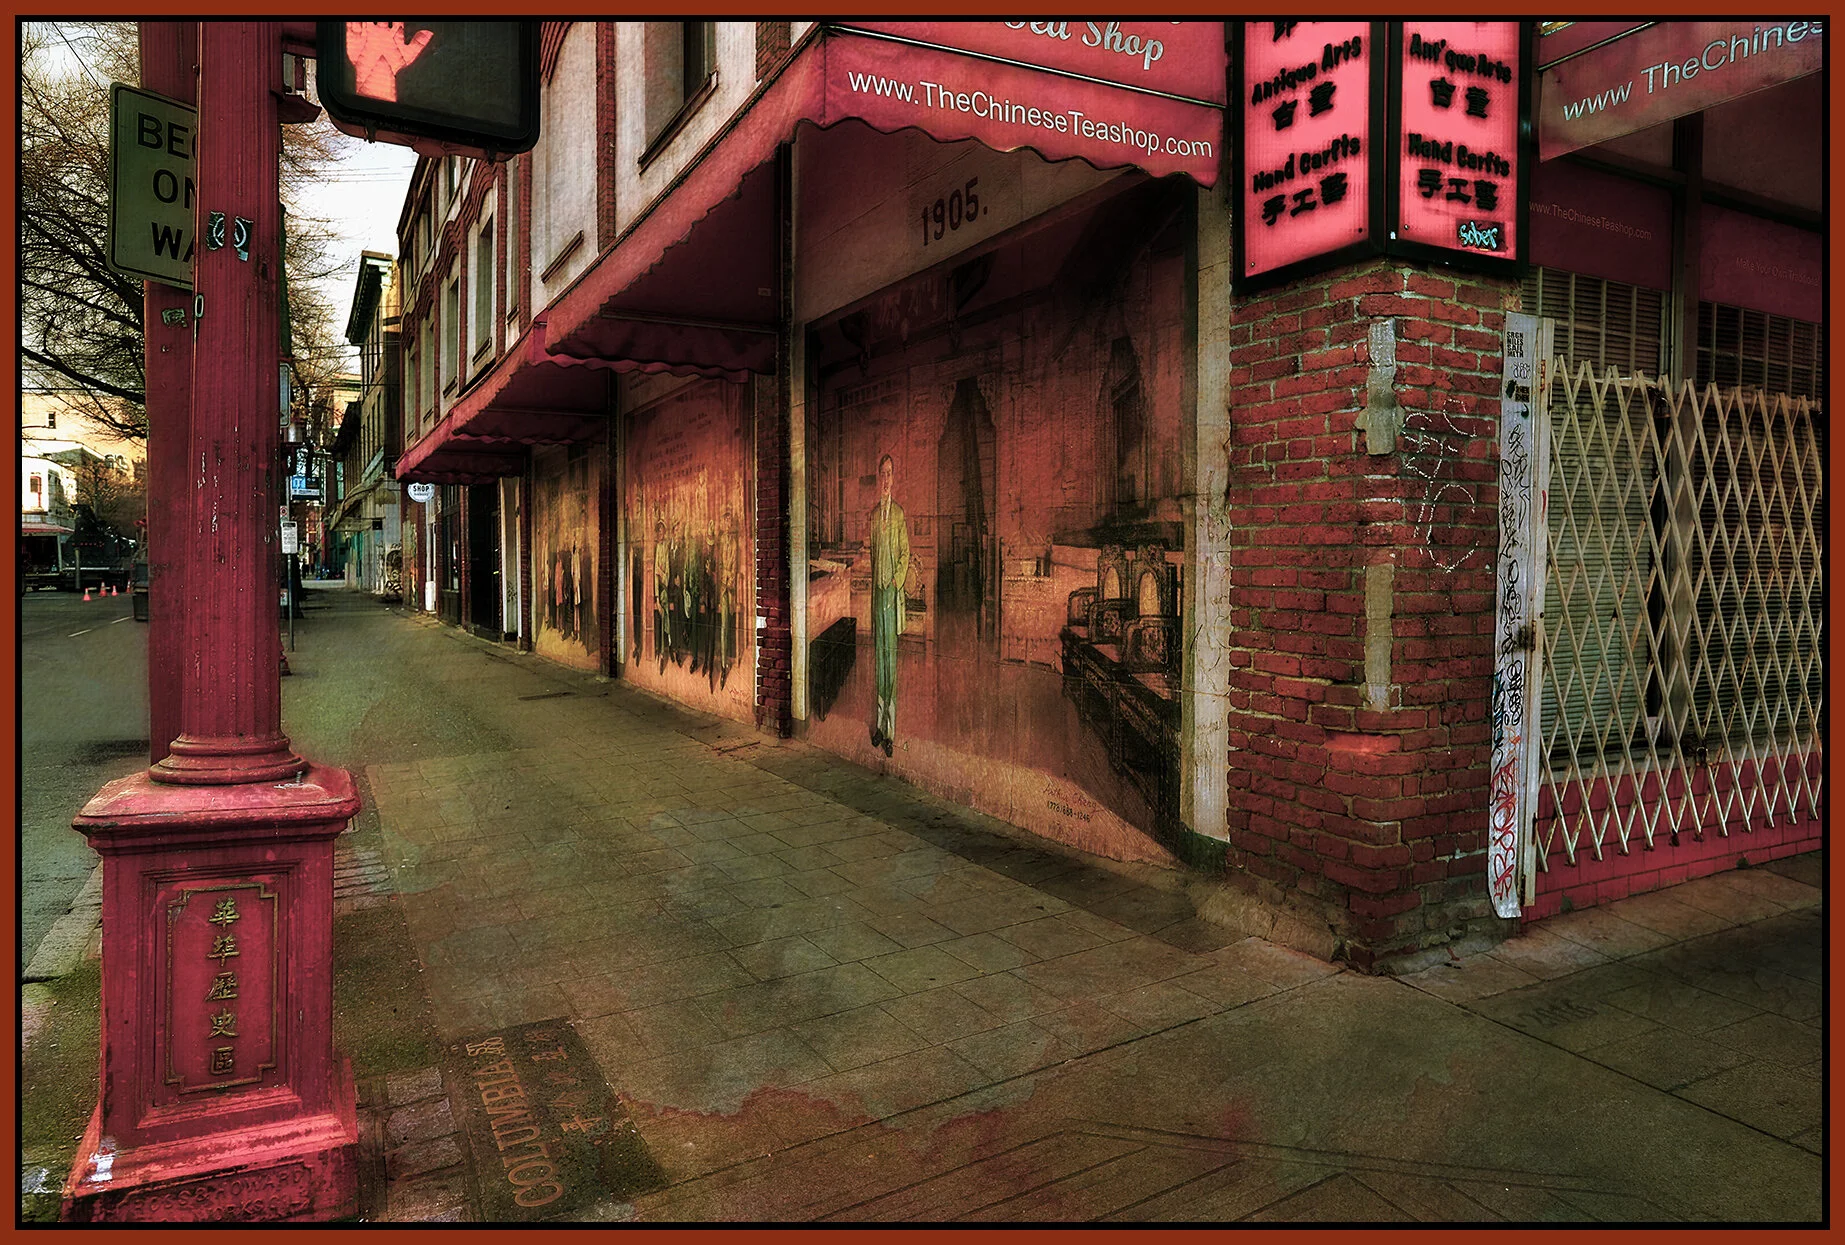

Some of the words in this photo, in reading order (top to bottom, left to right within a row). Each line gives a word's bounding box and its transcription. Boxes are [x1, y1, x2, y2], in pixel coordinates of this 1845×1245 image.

[1081, 22, 1165, 71] Shop
[1251, 61, 1318, 105] Antique
[1321, 36, 1362, 71] Arts
[1476, 53, 1512, 84] Arts
[137, 112, 197, 160] BE
[847, 70, 1214, 159] www.TheChineseTeashop.com
[1252, 154, 1295, 193] Hand
[1299, 133, 1361, 174] Carfts
[1408, 133, 1453, 164] Hand
[1456, 144, 1511, 177] Carfts
[921, 176, 989, 247] 1905.
[1528, 199, 1652, 241] www.TheChineseTeashop.com
[204, 895, 242, 1077] 華埠歷史區
[473, 1057, 564, 1208] COLUMBIA
